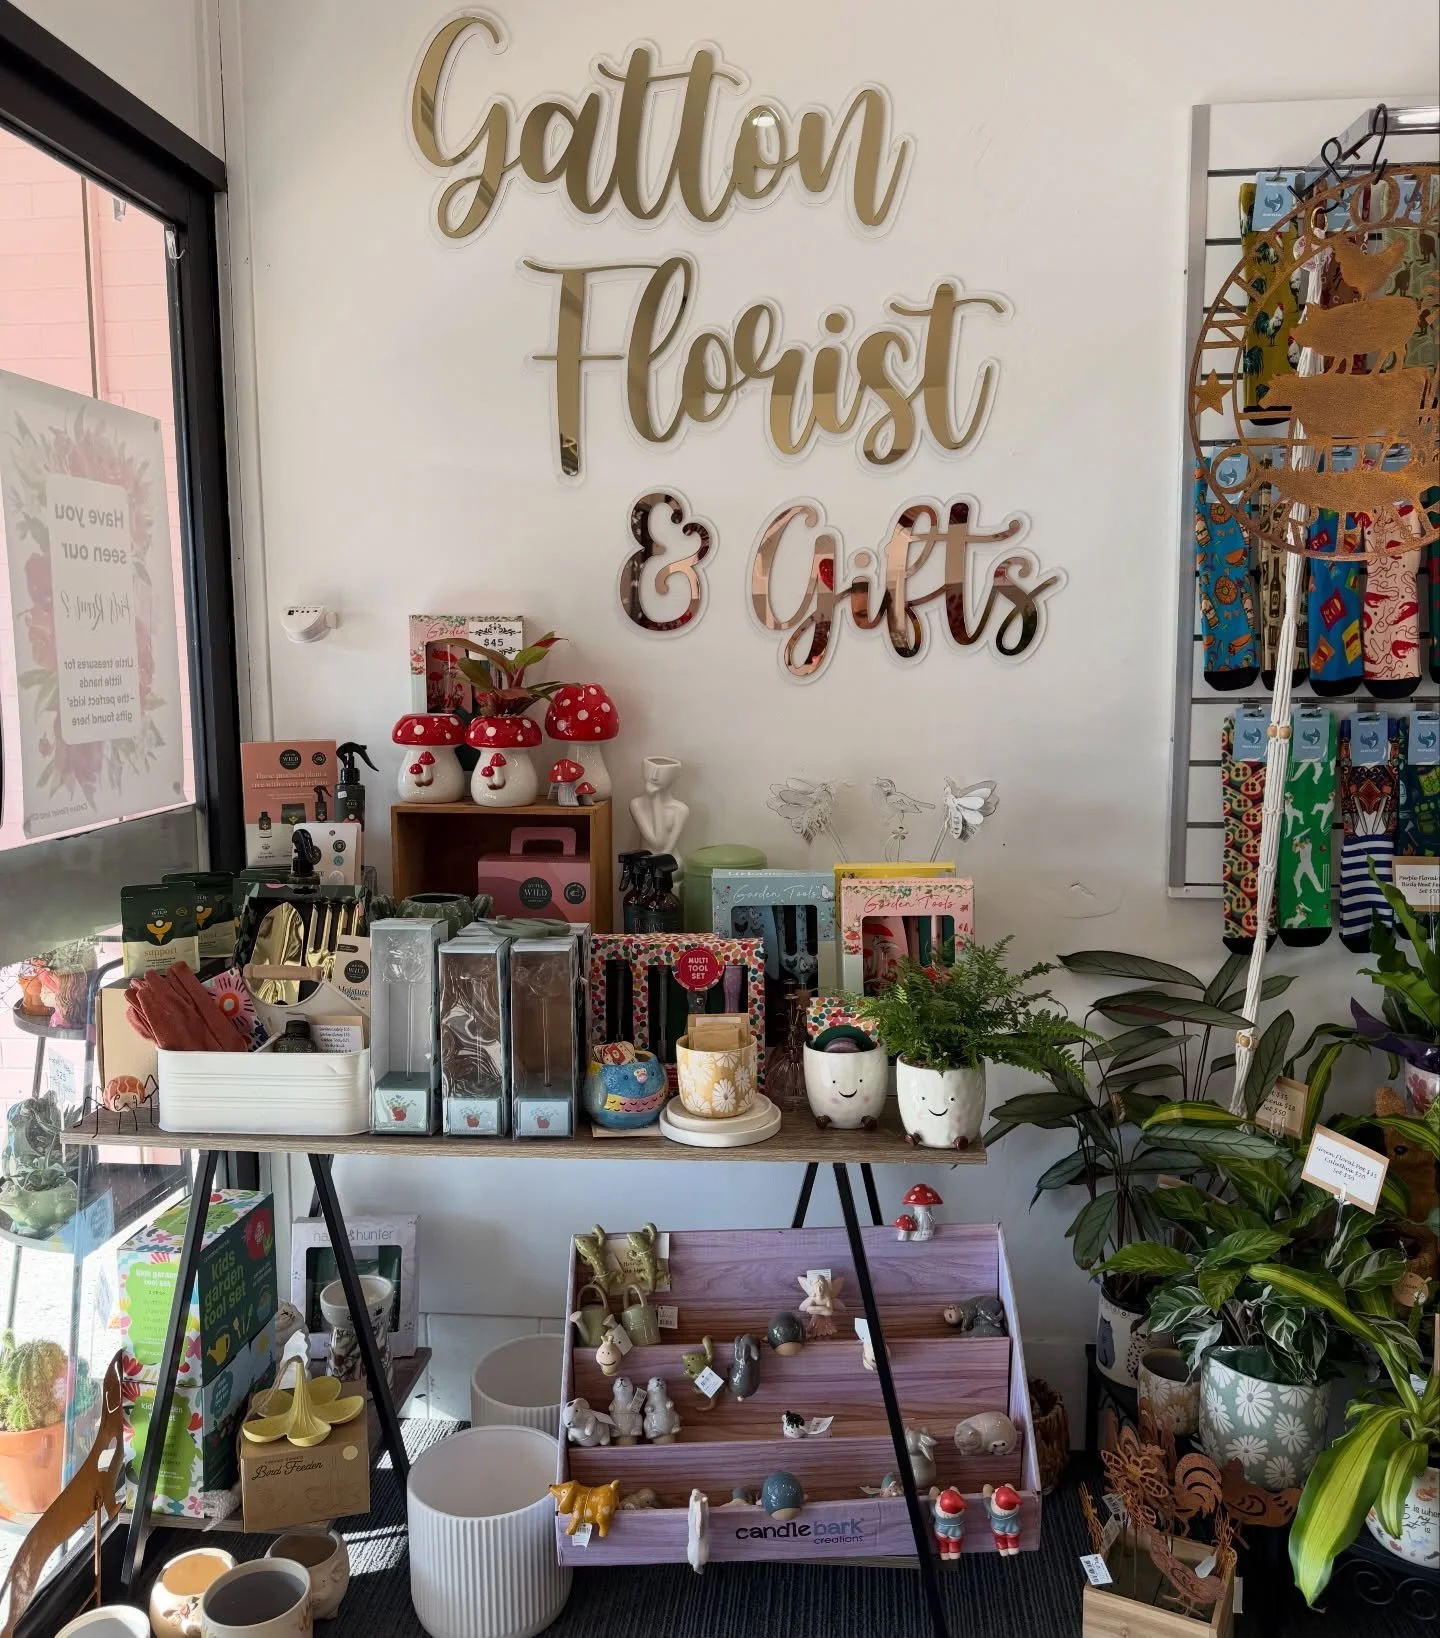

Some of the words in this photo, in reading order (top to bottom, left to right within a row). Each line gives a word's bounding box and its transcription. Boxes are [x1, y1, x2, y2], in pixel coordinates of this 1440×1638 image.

[411, 16, 908, 239] Gatton
[522, 256, 1005, 477] Florist
[622, 492, 711, 632] &
[752, 502, 1058, 677] Gifts
[427, 622, 468, 638] Garden
[483, 638, 504, 648] $45
[523, 888, 548, 897] WILD
[733, 884, 780, 904] Garden
[783, 883, 817, 901] Tools
[863, 893, 914, 914] Garden
[916, 894, 956, 910] Tools
[143, 947, 177, 957] support
[688, 964, 709, 972] TOOL
[691, 972, 706, 980] SET
[1335, 1154, 1355, 1166] Floral
[356, 1228, 394, 1241] hunter
[211, 1250, 236, 1282] kids
[204, 1264, 245, 1312] garden
[203, 1300, 228, 1331] tool
[228, 1281, 247, 1309] set
[250, 1464, 283, 1481] Bird
[283, 1460, 324, 1475] Feeder
[735, 1522, 812, 1540] candle
[813, 1535, 865, 1545] creations
